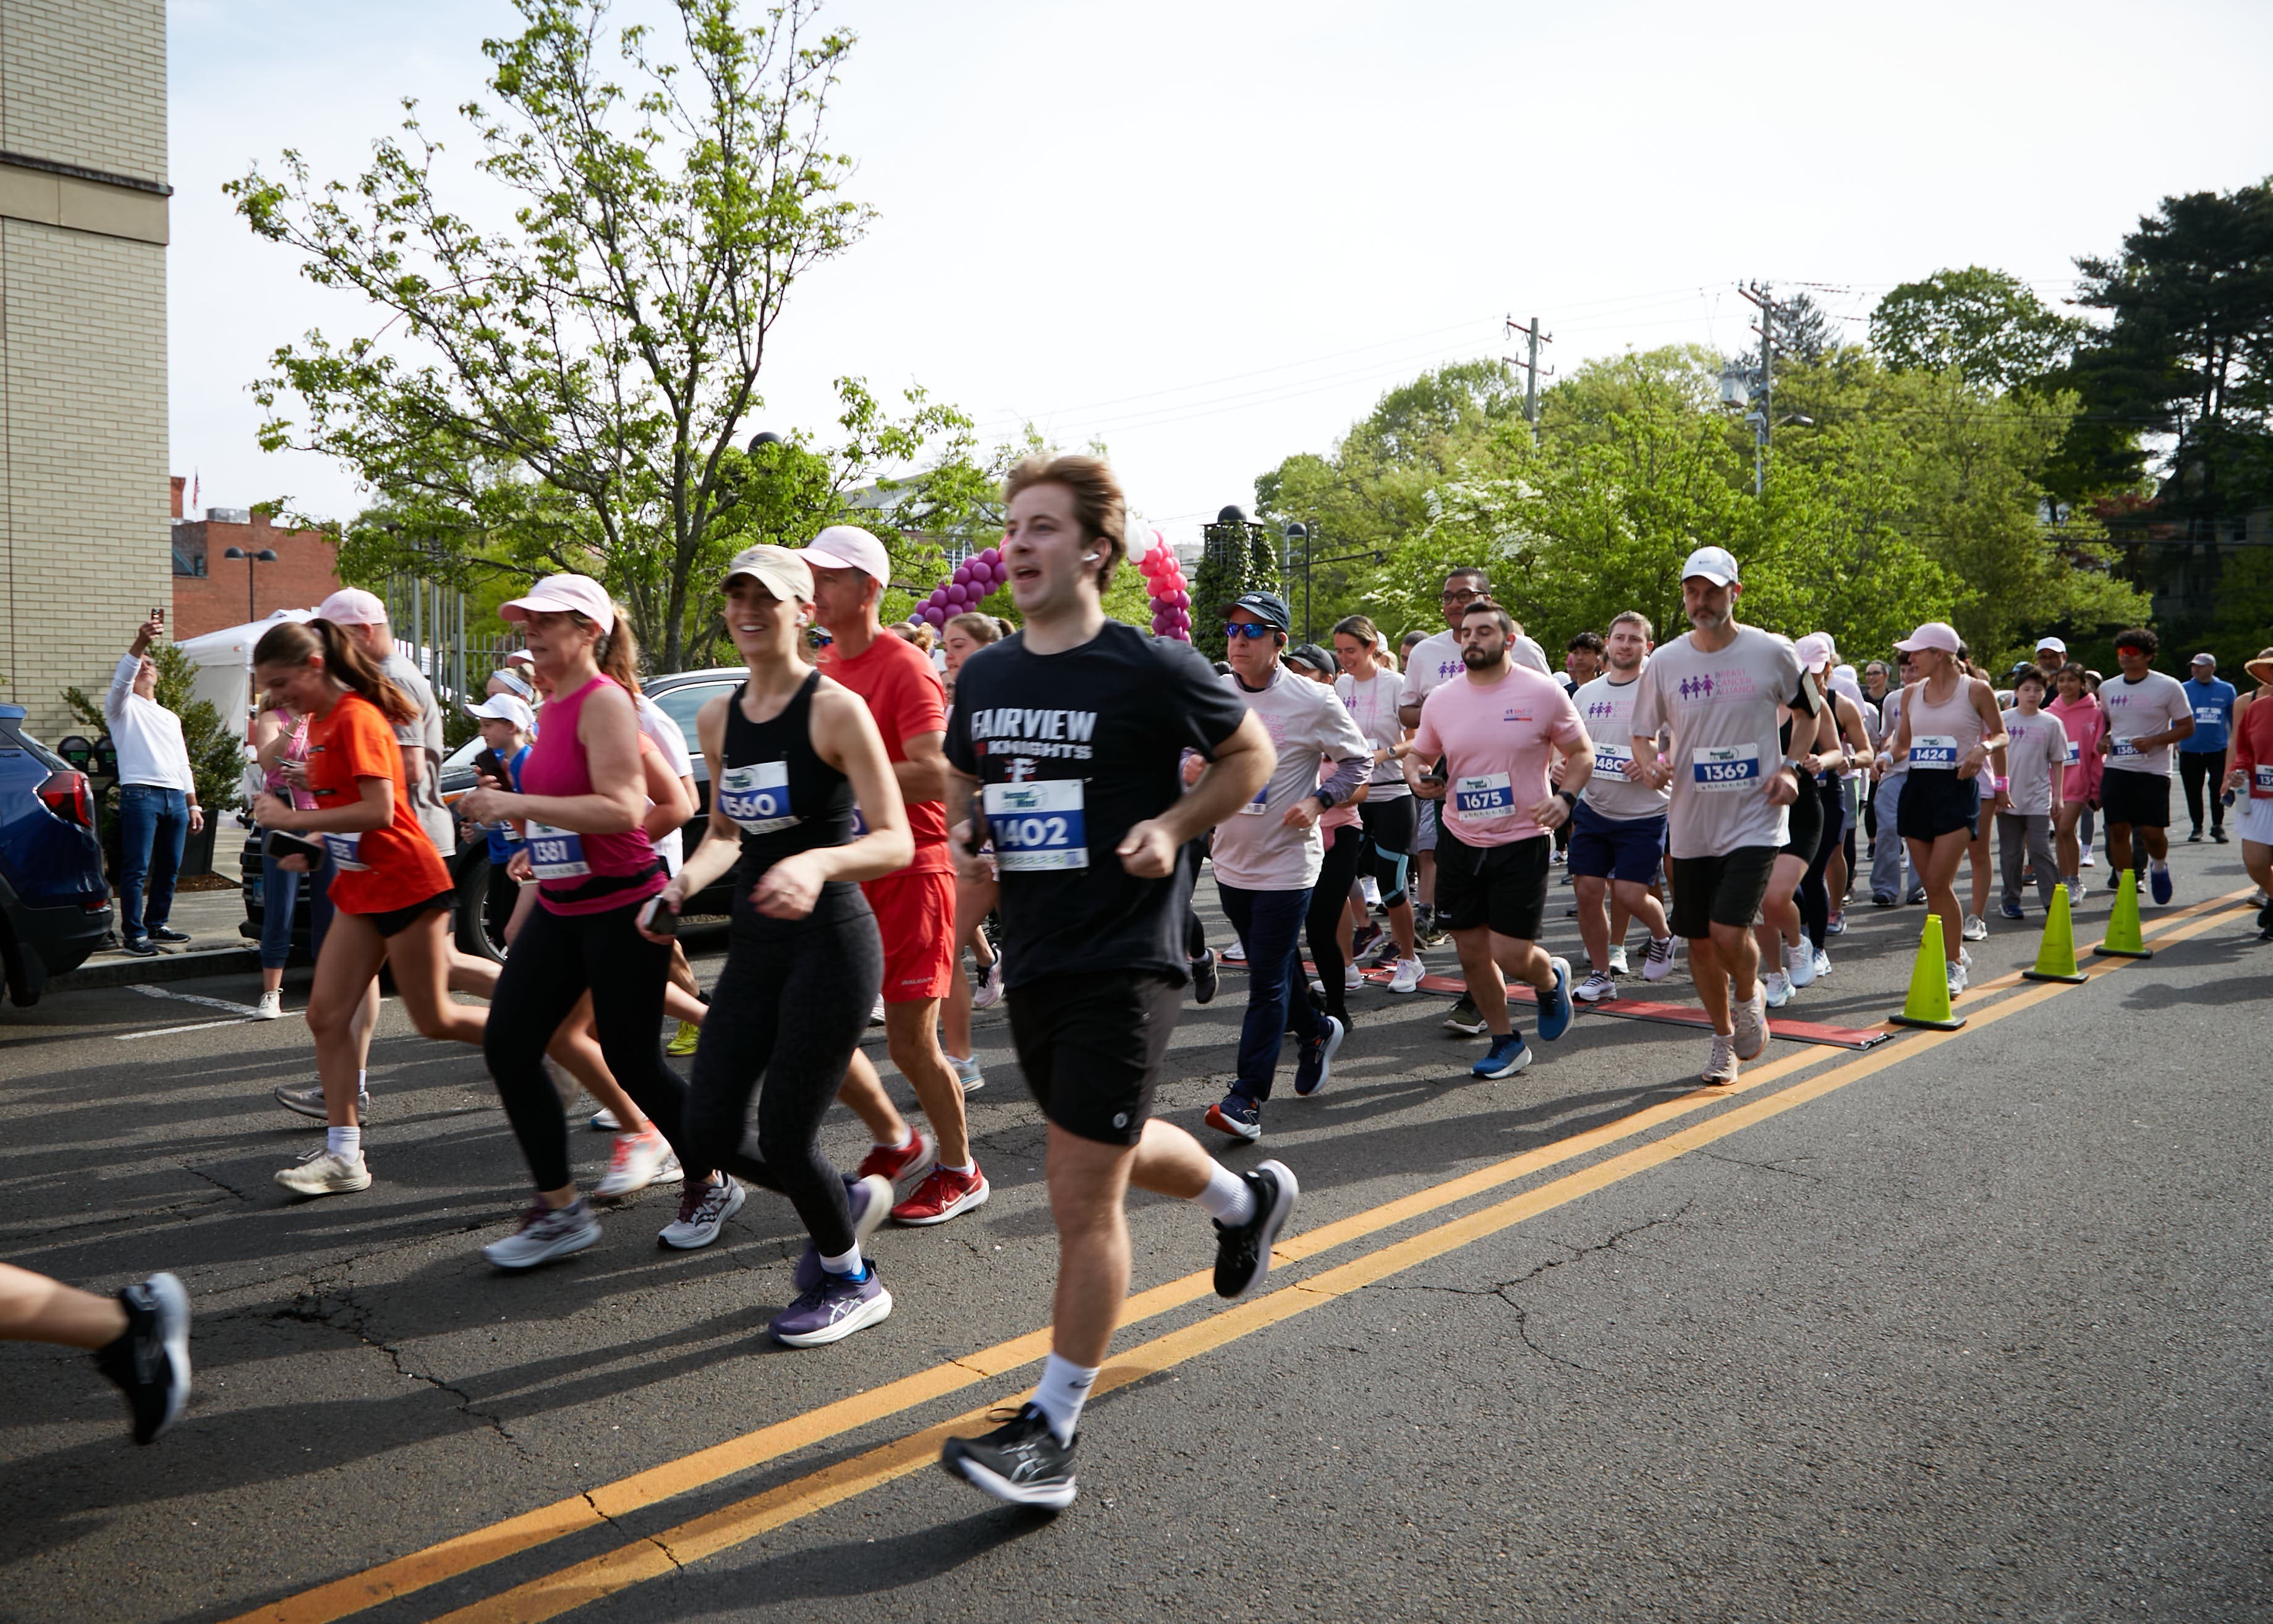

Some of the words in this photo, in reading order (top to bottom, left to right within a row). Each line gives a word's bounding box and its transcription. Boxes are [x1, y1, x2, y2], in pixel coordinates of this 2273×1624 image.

[971, 708, 1098, 742] FAIRVIEW
[987, 741, 1093, 759] KNIGHTS
[1916, 749, 1948, 760] 1424
[1704, 762, 1749, 780] 1369
[1464, 791, 1503, 809] 1675
[993, 817, 1069, 847] 1402
